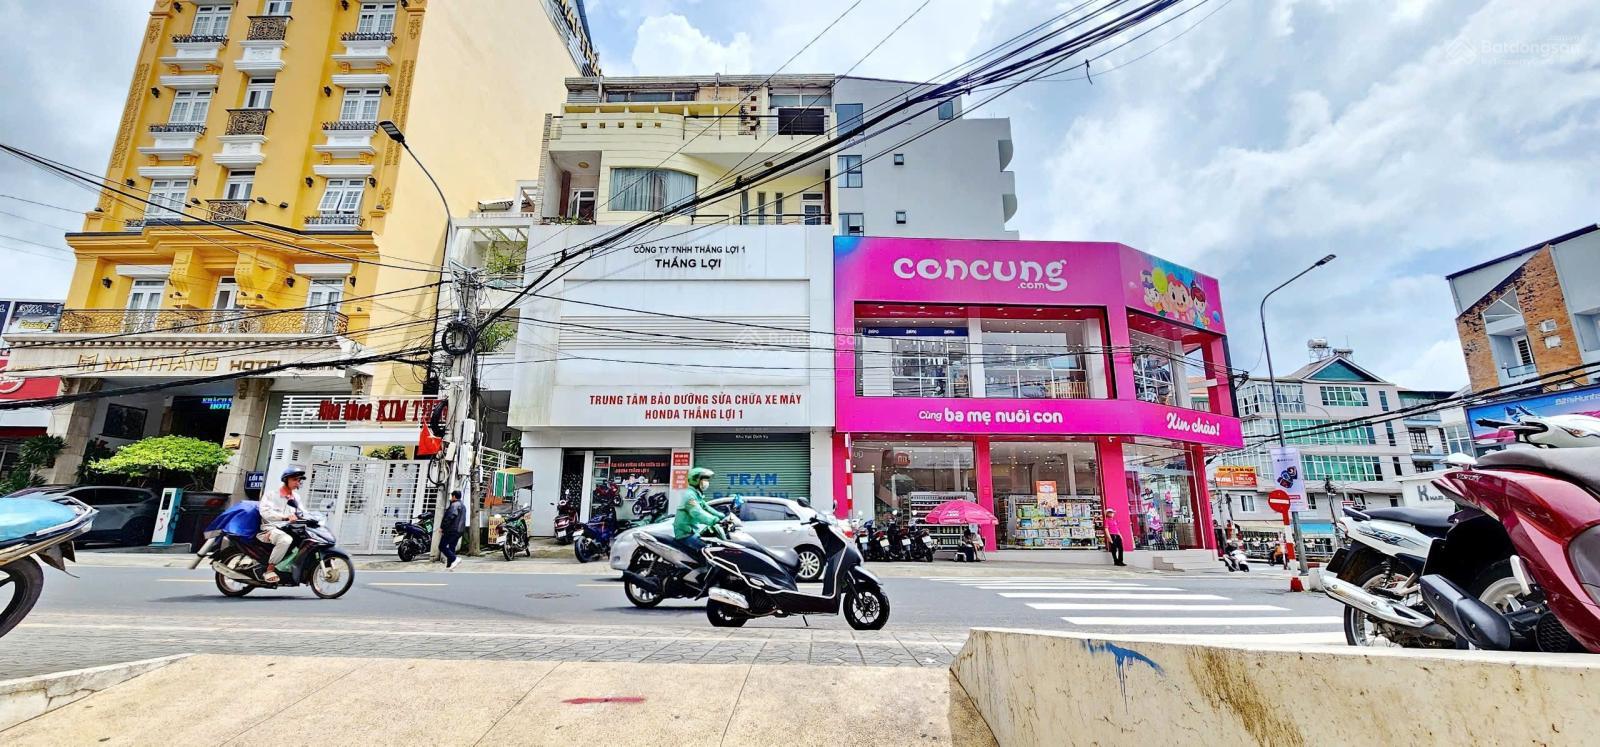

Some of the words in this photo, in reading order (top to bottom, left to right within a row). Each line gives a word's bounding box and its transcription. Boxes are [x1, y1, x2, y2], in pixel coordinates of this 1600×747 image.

[633, 244, 657, 254] CÔNG
[659, 246, 670, 254] TY
[671, 246, 693, 254] TNHH
[695, 244, 723, 254] THẮNG
[725, 246, 739, 255] LỢI
[741, 246, 746, 254] 1
[655, 256, 697, 268] THẮNG
[701, 259, 722, 270] LỢI
[1017, 281, 1048, 289] .com
[105, 356, 141, 372] MAI
[146, 349, 218, 372] THẮNG
[589, 395, 624, 405] TRUNG
[626, 393, 648, 405] TÂM
[650, 392, 671, 405] BẢO
[674, 392, 709, 405] DƯỠNG
[711, 391, 732, 405] SỬA
[735, 392, 763, 405] CHỮA
[765, 395, 778, 404] XE
[780, 392, 802, 405] MÁY
[318, 400, 341, 420] Nha
[376, 400, 408, 421] KIM
[644, 409, 680, 420] HONDA
[683, 406, 717, 419] THẮNG
[719, 408, 736, 421] LỢI
[738, 409, 744, 419] 1
[919, 410, 942, 421] Cùng
[944, 407, 965, 423] ba
[966, 410, 991, 425] mẹ
[995, 409, 1031, 423] nuôi
[1033, 411, 1063, 423] con
[1166, 412, 1190, 432] Xin
[1191, 417, 1220, 436] chào!
[1417, 485, 1429, 501] K
